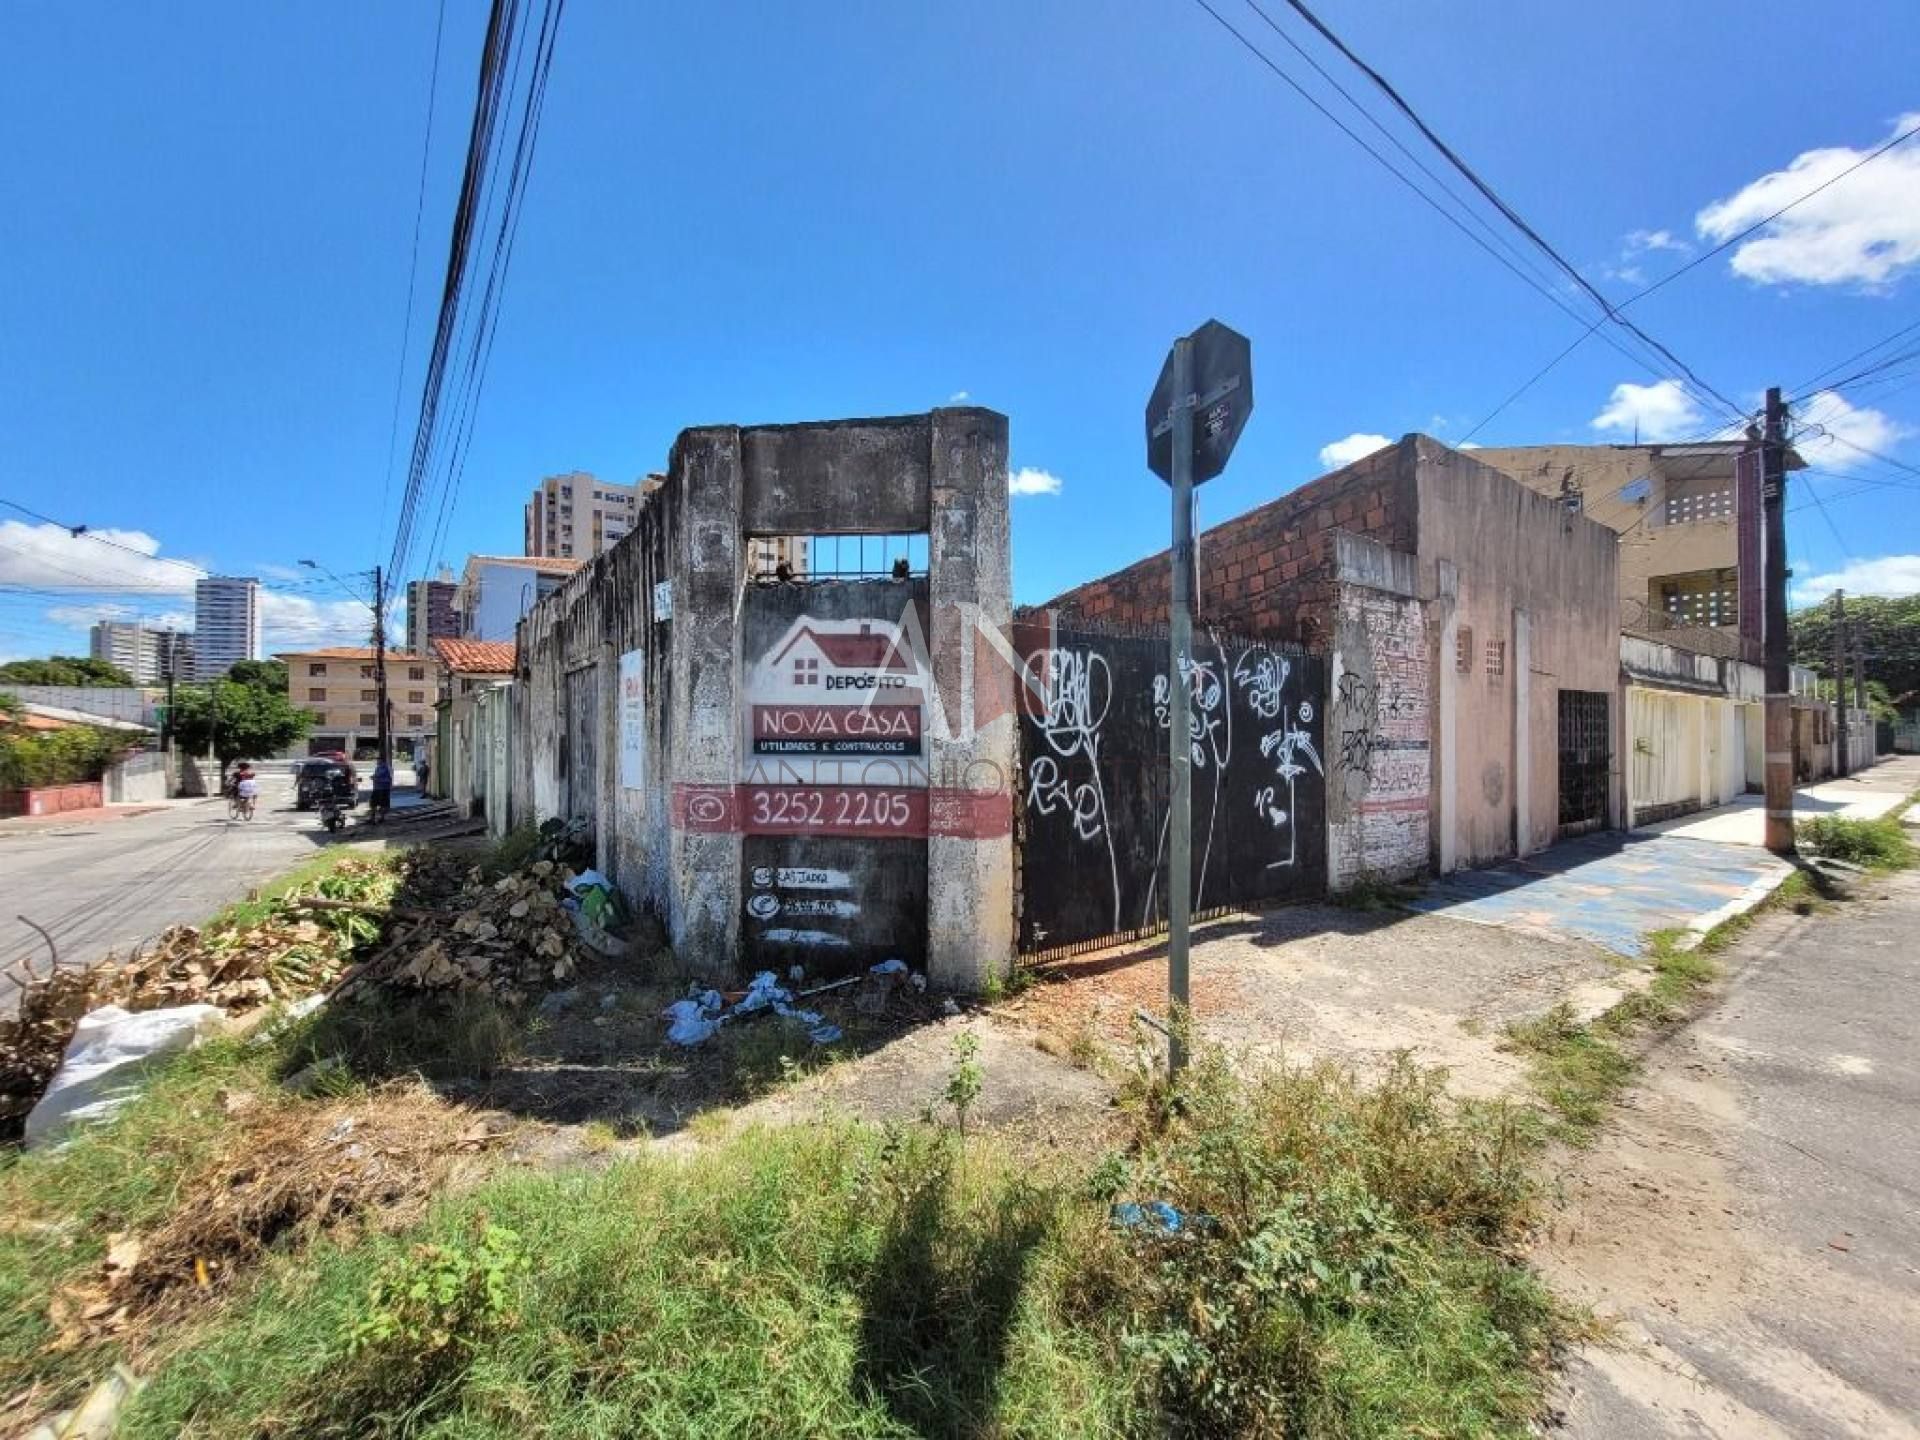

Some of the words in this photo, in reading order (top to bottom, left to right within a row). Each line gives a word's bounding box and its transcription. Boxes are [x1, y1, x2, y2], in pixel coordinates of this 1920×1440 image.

[762, 709, 838, 735] NOVA
[844, 709, 914, 736] CASA
[752, 791, 824, 826] 3252
[835, 792, 911, 826] 2205
